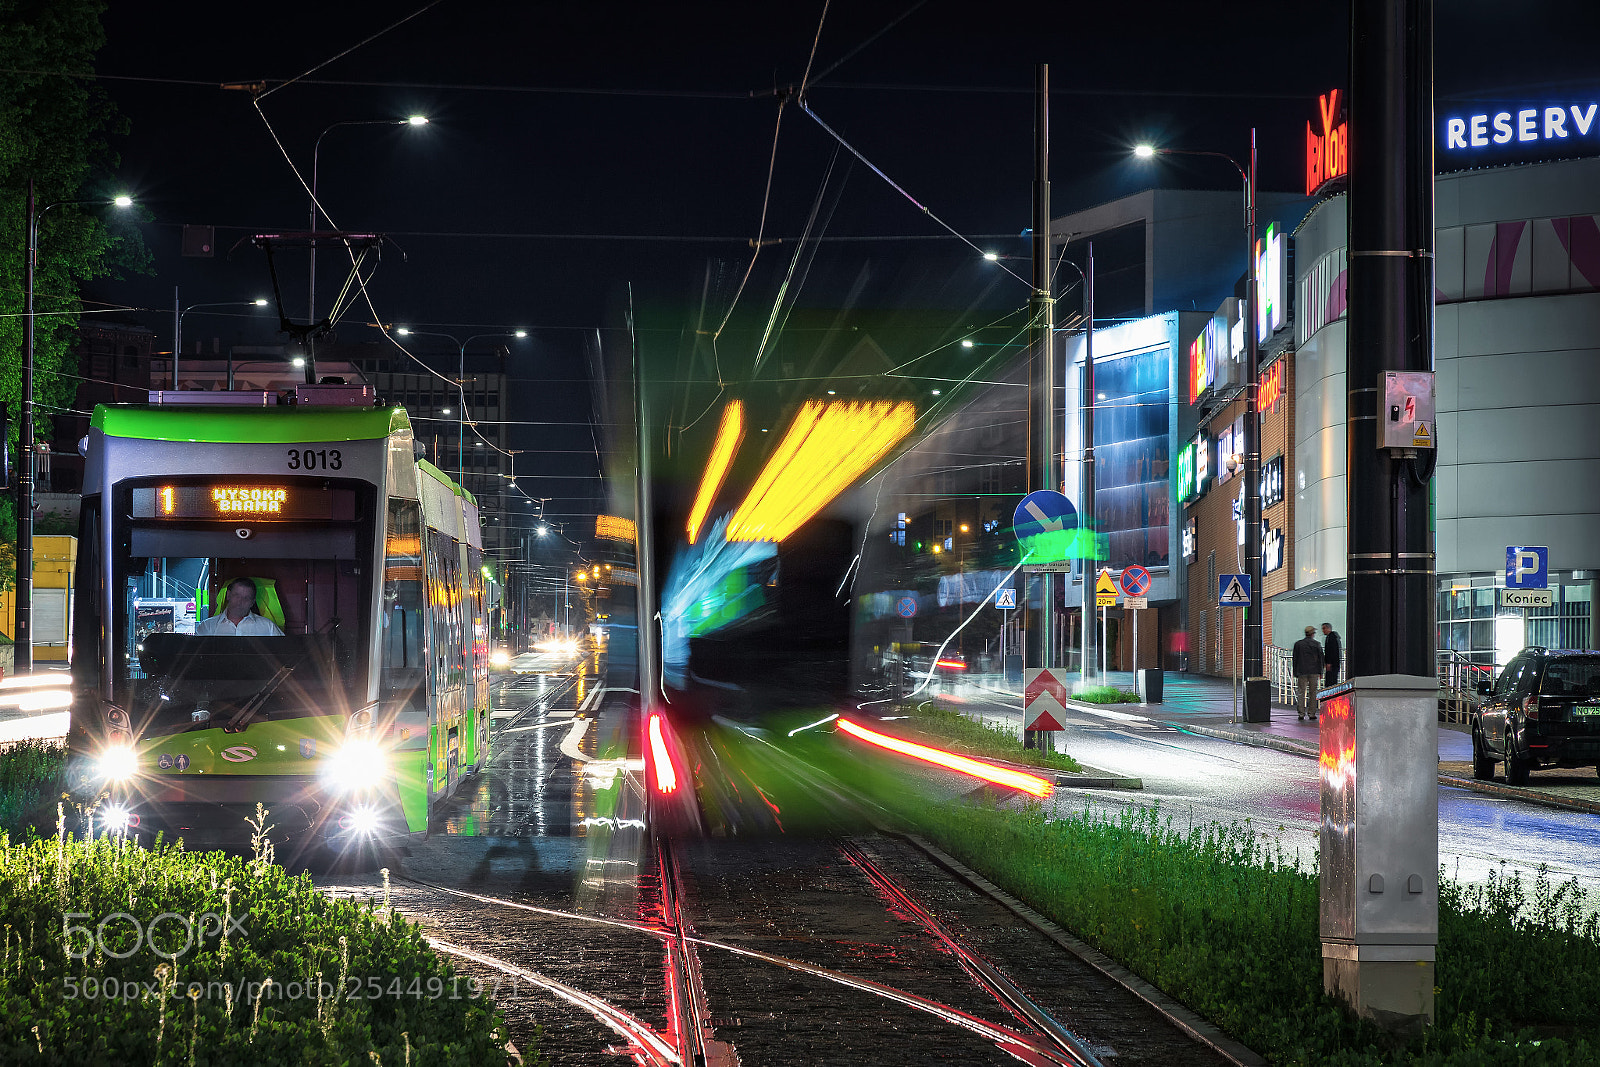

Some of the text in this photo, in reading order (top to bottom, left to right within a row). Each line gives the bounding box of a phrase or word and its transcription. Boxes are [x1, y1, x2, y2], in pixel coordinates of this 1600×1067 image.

[1447, 103, 1599, 150] RESERV
[287, 449, 343, 471] 3013
[161, 486, 286, 514] 1 WYSOKA
[218, 500, 280, 513] BRAMA
[1515, 550, 1540, 585] P
[1505, 592, 1550, 605] Koniec
